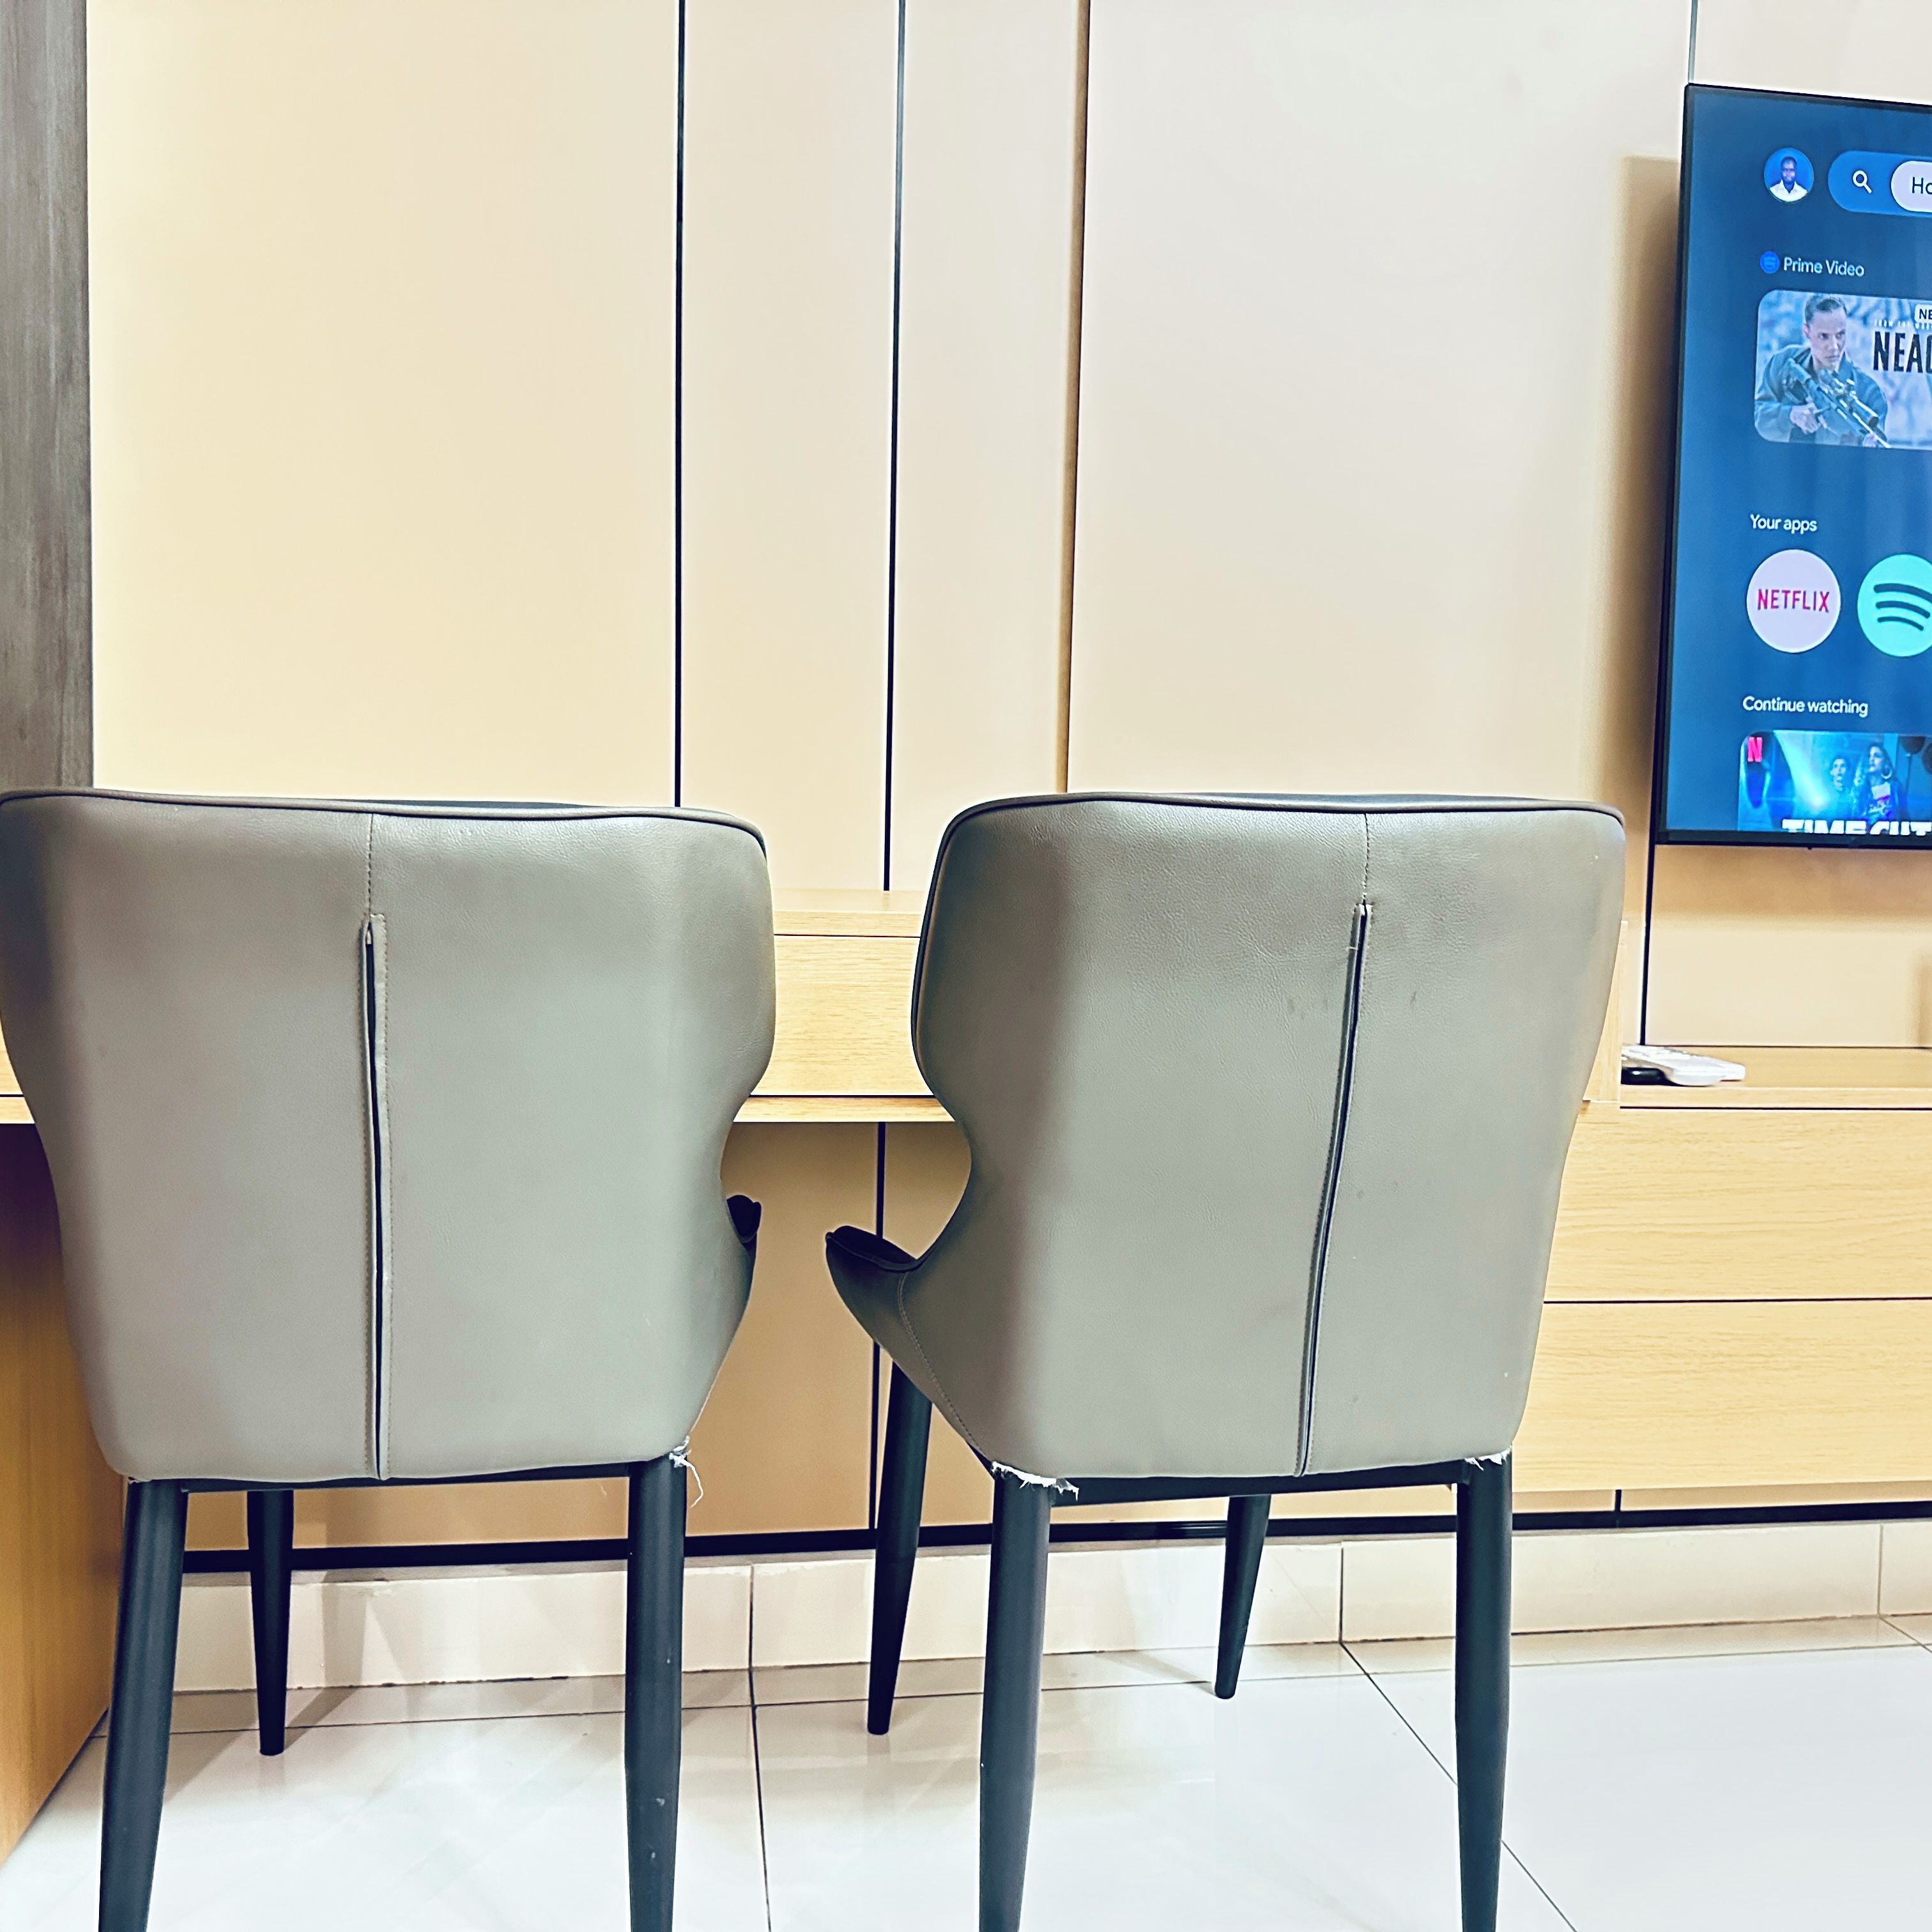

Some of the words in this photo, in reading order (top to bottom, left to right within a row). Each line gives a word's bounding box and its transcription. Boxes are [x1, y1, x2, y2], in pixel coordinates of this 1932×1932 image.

[1784, 257, 1823, 273] Prime
[1825, 259, 1865, 277] Video
[1750, 514, 1781, 530] Your
[1783, 519, 1817, 534] apps
[1757, 588, 1830, 613] NETFLIX
[1742, 696, 1805, 712] Continue
[1807, 699, 1869, 717] watching
[1747, 737, 1763, 762] N
